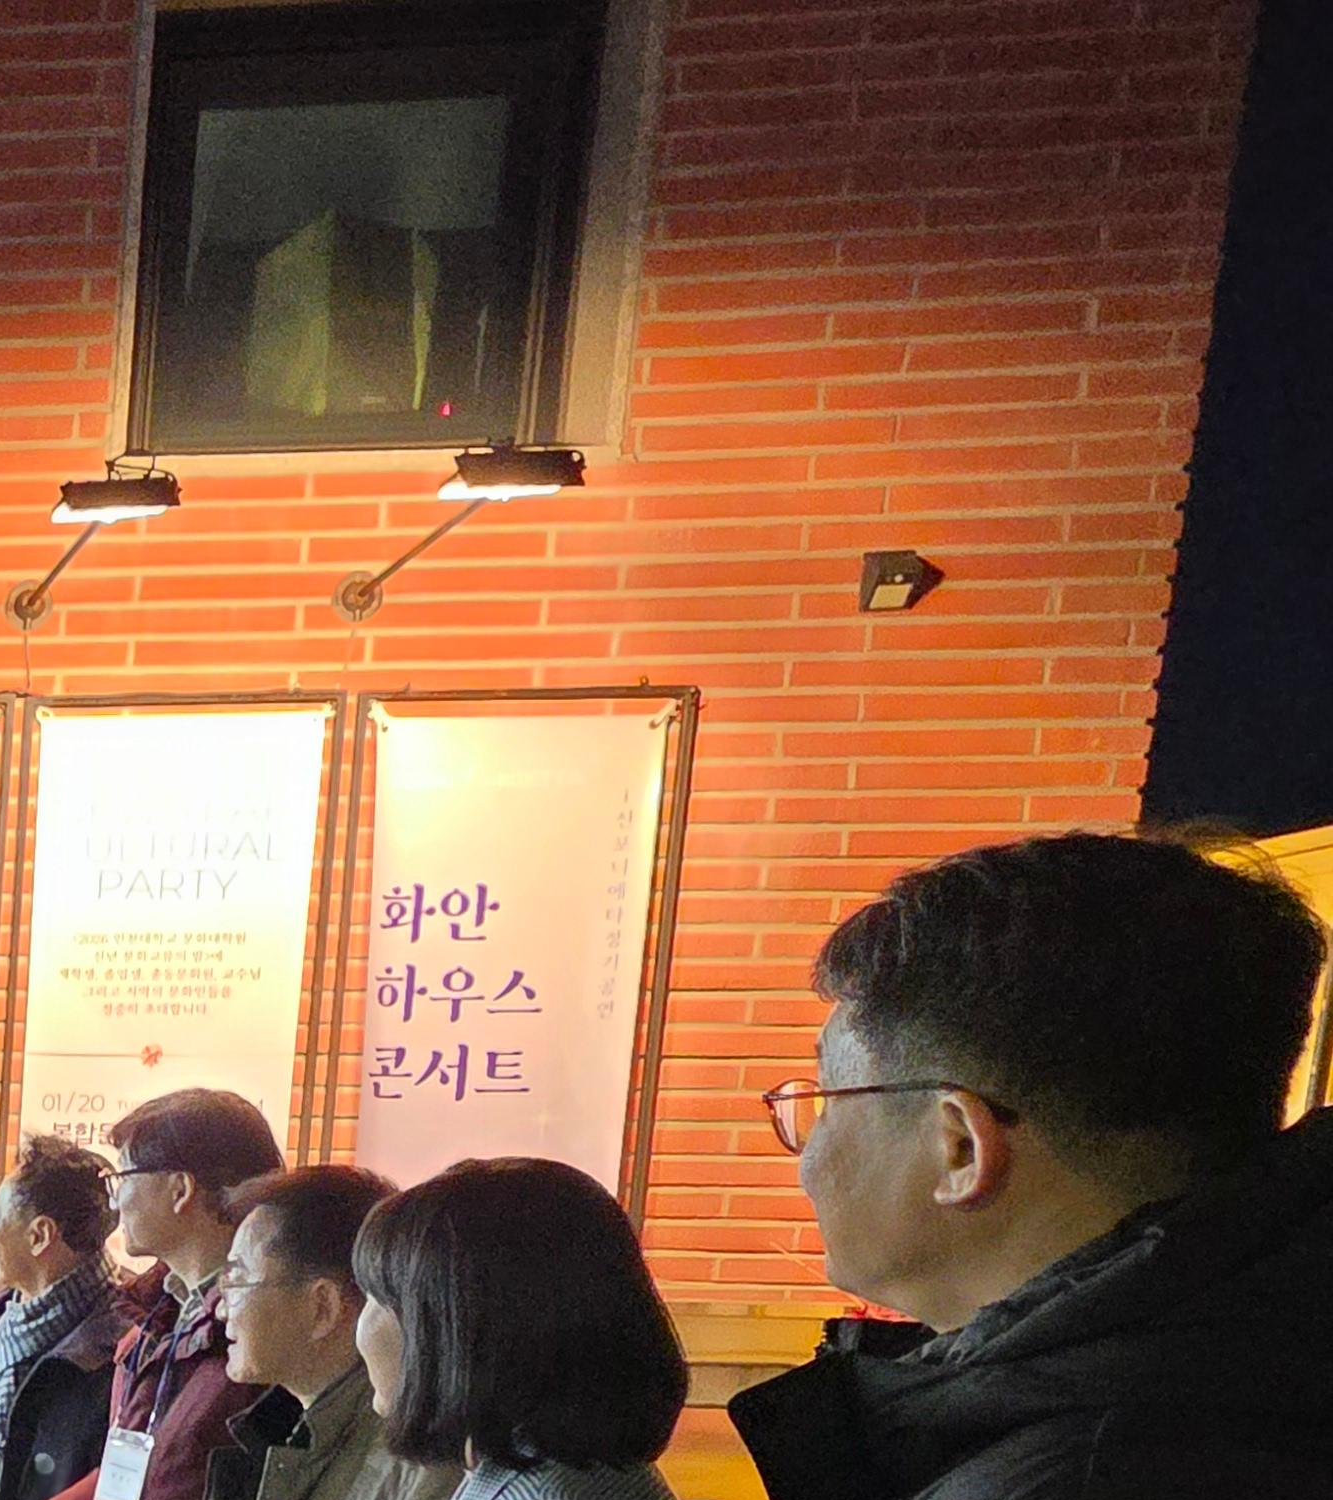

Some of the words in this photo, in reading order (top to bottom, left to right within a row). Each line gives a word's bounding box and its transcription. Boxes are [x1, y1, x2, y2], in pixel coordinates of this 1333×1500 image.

[96, 867, 239, 900] PARTY
[379, 882, 502, 944] 화안
[374, 963, 544, 1023] 하우스
[367, 1043, 532, 1102] 콘서트
[41, 1091, 106, 1114] 01/20
